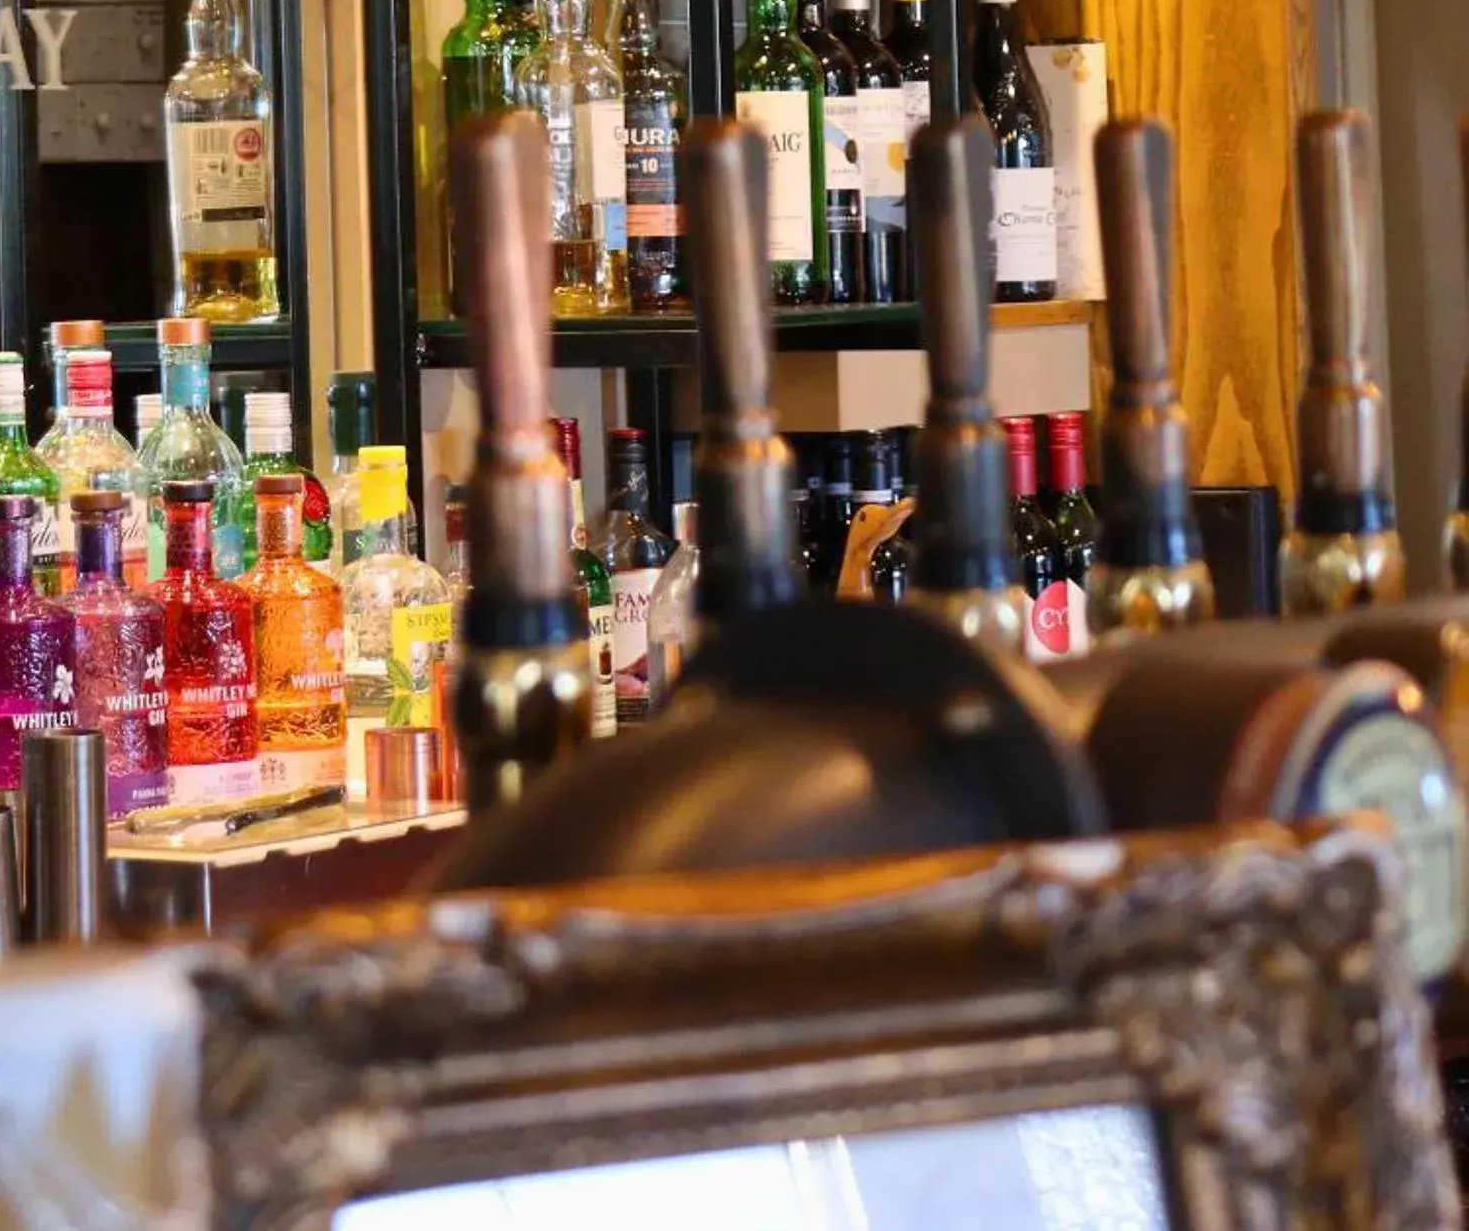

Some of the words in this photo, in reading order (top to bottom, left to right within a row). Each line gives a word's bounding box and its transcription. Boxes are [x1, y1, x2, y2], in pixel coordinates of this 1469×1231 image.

[641, 157, 660, 174] 10
[182, 683, 244, 704] WHITLEY
[225, 700, 249, 719] GIN
[12, 711, 73, 732] WHITLEY
